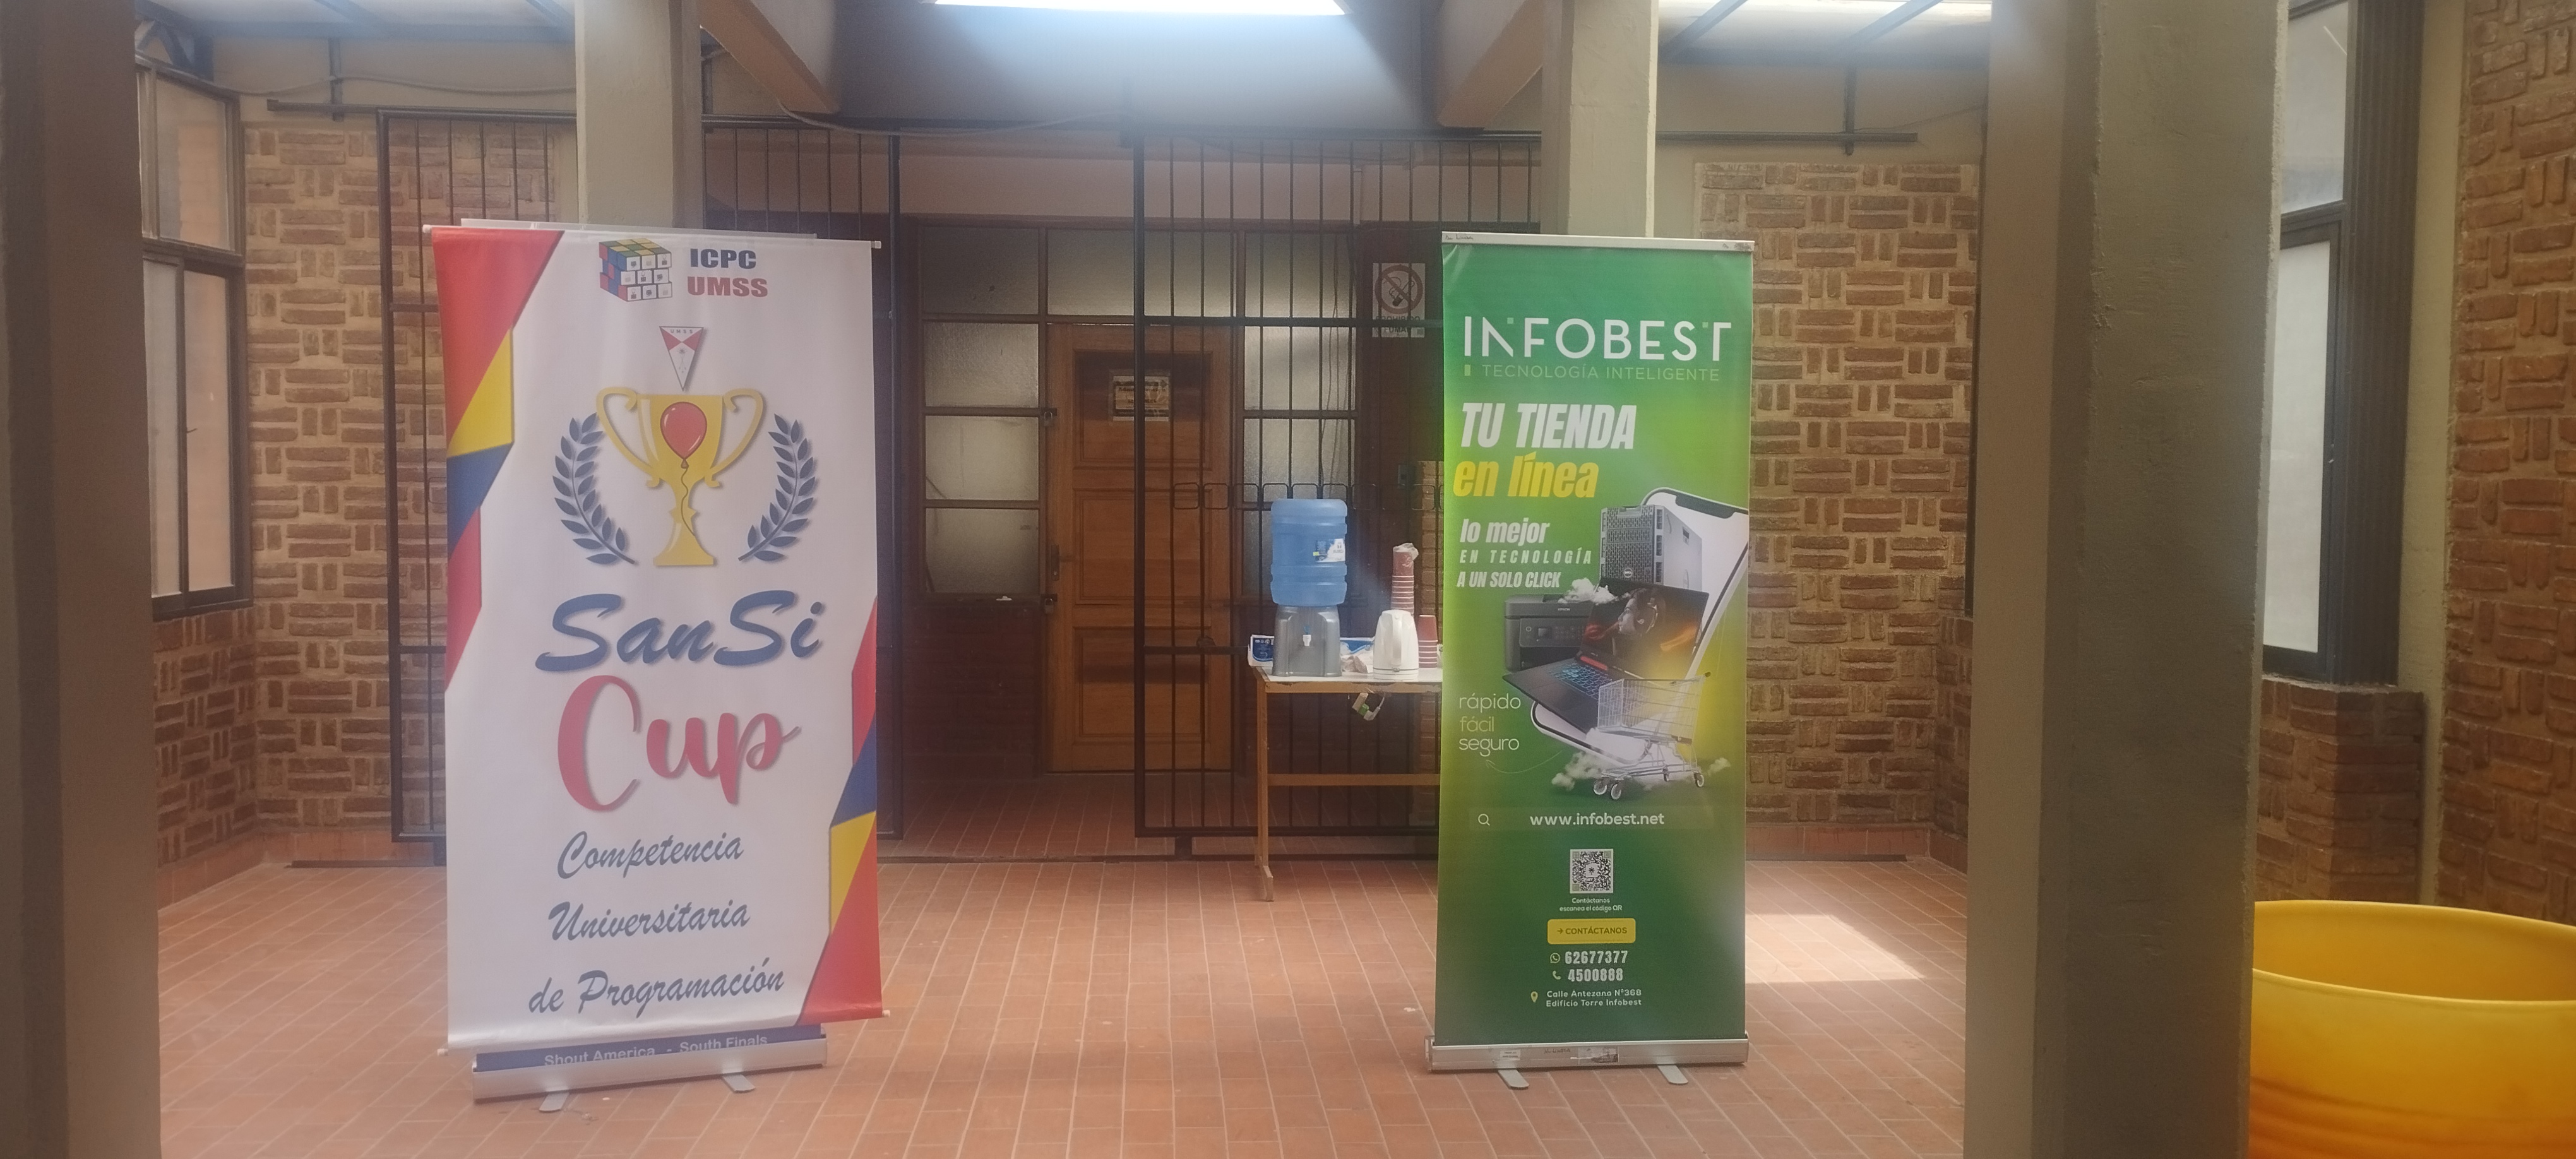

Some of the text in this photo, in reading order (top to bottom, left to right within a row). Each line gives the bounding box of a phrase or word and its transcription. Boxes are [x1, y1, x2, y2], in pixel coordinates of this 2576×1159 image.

[690, 248, 756, 270] ICPC
[687, 276, 768, 297] UMSS
[1464, 316, 1731, 361] INFOBEST
[1482, 363, 1719, 381] TECNOLOGÍA INTELIGENTE
[1461, 403, 1637, 449] TU TIENDA
[1453, 451, 1599, 497] en línea
[1460, 518, 1551, 546] lo mejor
[1460, 547, 1592, 564] EN TECNOLOGÍA
[1457, 571, 1561, 588] A UN SOLO CLICK
[535, 590, 823, 672] SanSi
[1459, 692, 1521, 713] rápido
[1460, 716, 1494, 732] fácil
[558, 675, 801, 812] Cup
[1459, 739, 1519, 757] seguro
[1530, 812, 1664, 825] www.infobest.net
[558, 831, 744, 879] Competencia
[548, 900, 751, 941] Universitaria
[1565, 926, 1628, 934] CONTÁCTANOS
[1565, 950, 1628, 964] 62677377
[1568, 968, 1623, 982] 4500888
[528, 957, 784, 1018] de Programación
[544, 1050, 588, 1066] Shout
[593, 1046, 655, 1061] America
[679, 1038, 721, 1054] South
[726, 1035, 767, 1048] Finals
